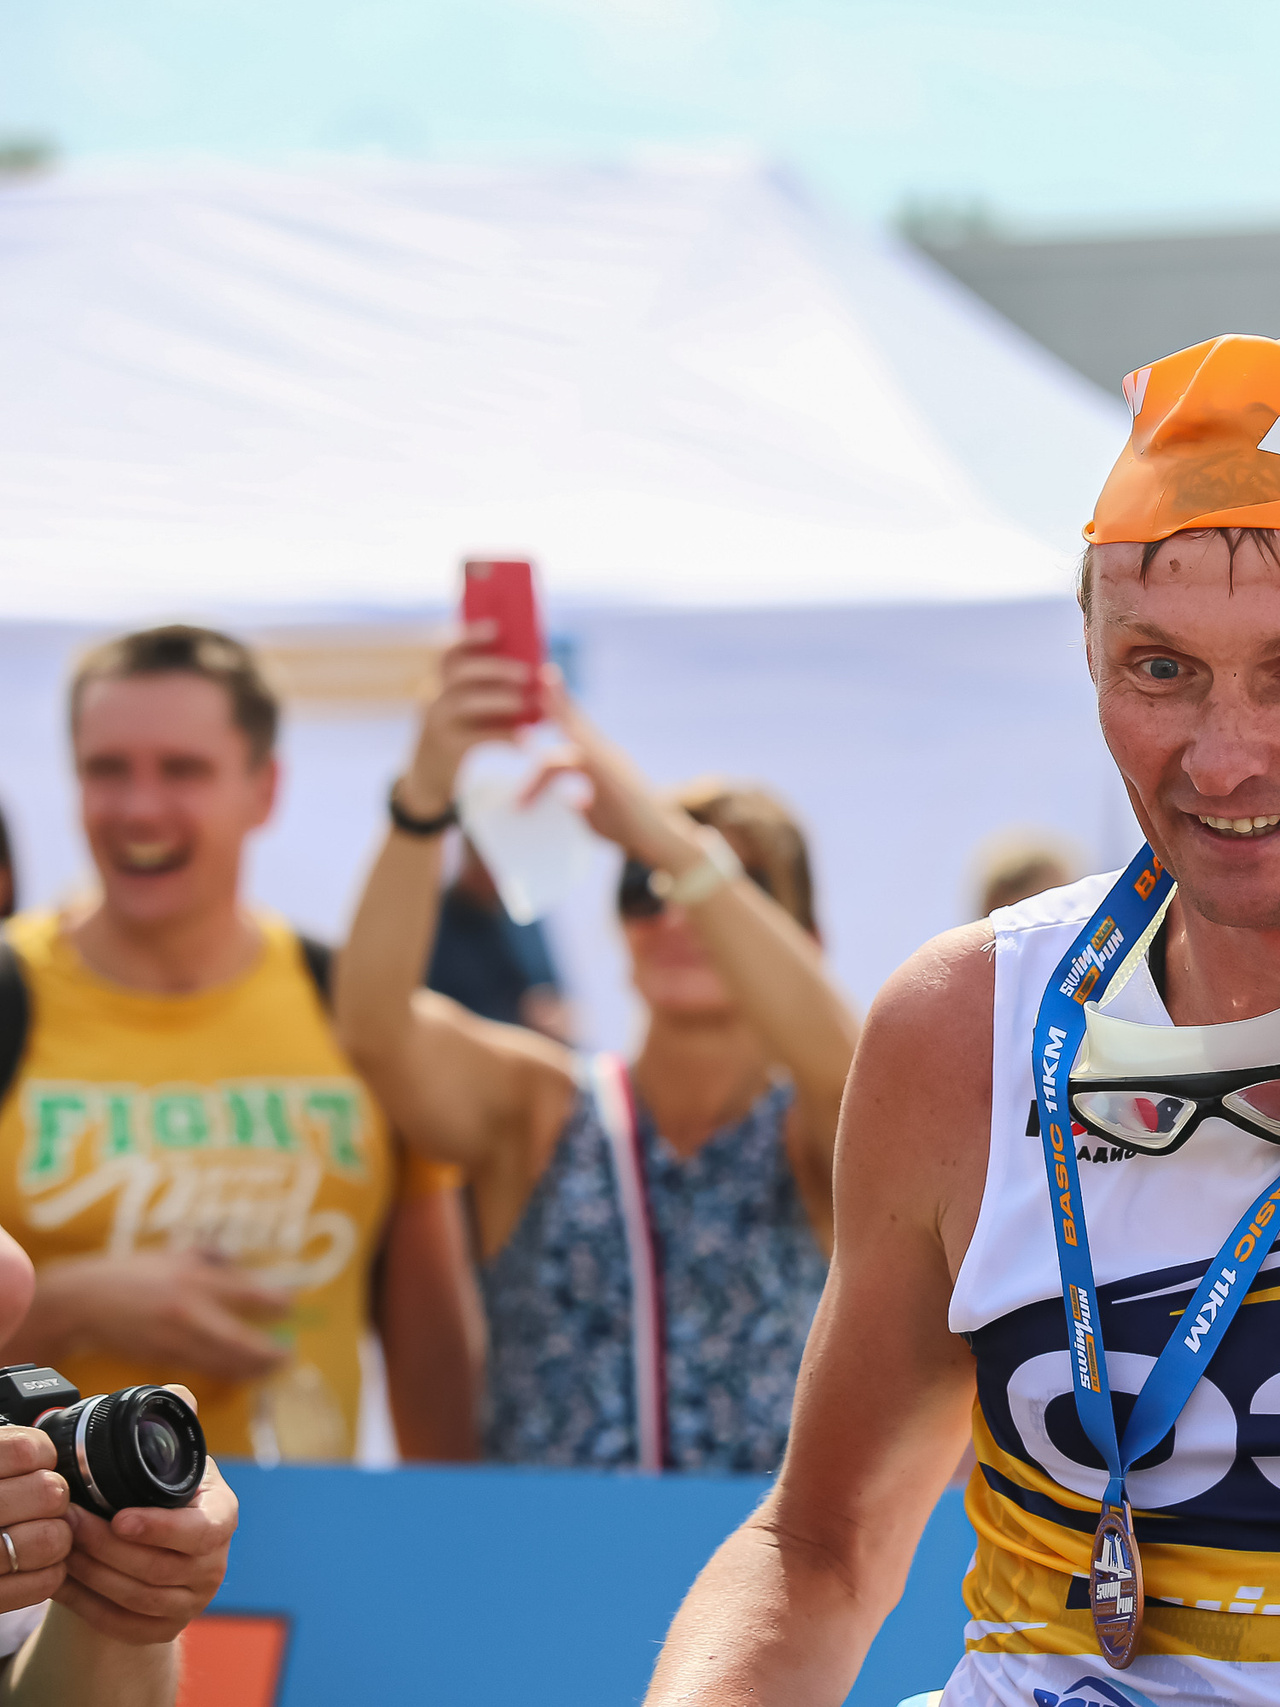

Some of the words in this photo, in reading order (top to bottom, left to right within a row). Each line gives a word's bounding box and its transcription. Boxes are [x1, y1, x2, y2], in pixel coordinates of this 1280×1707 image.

[1043, 1026, 1068, 1114] 11KM
[1049, 1122, 1079, 1247] BASIC
[1076, 1145, 1138, 1164] АДИО
[1183, 1267, 1238, 1354] 11KM
[22, 1377, 61, 1391] SONY
